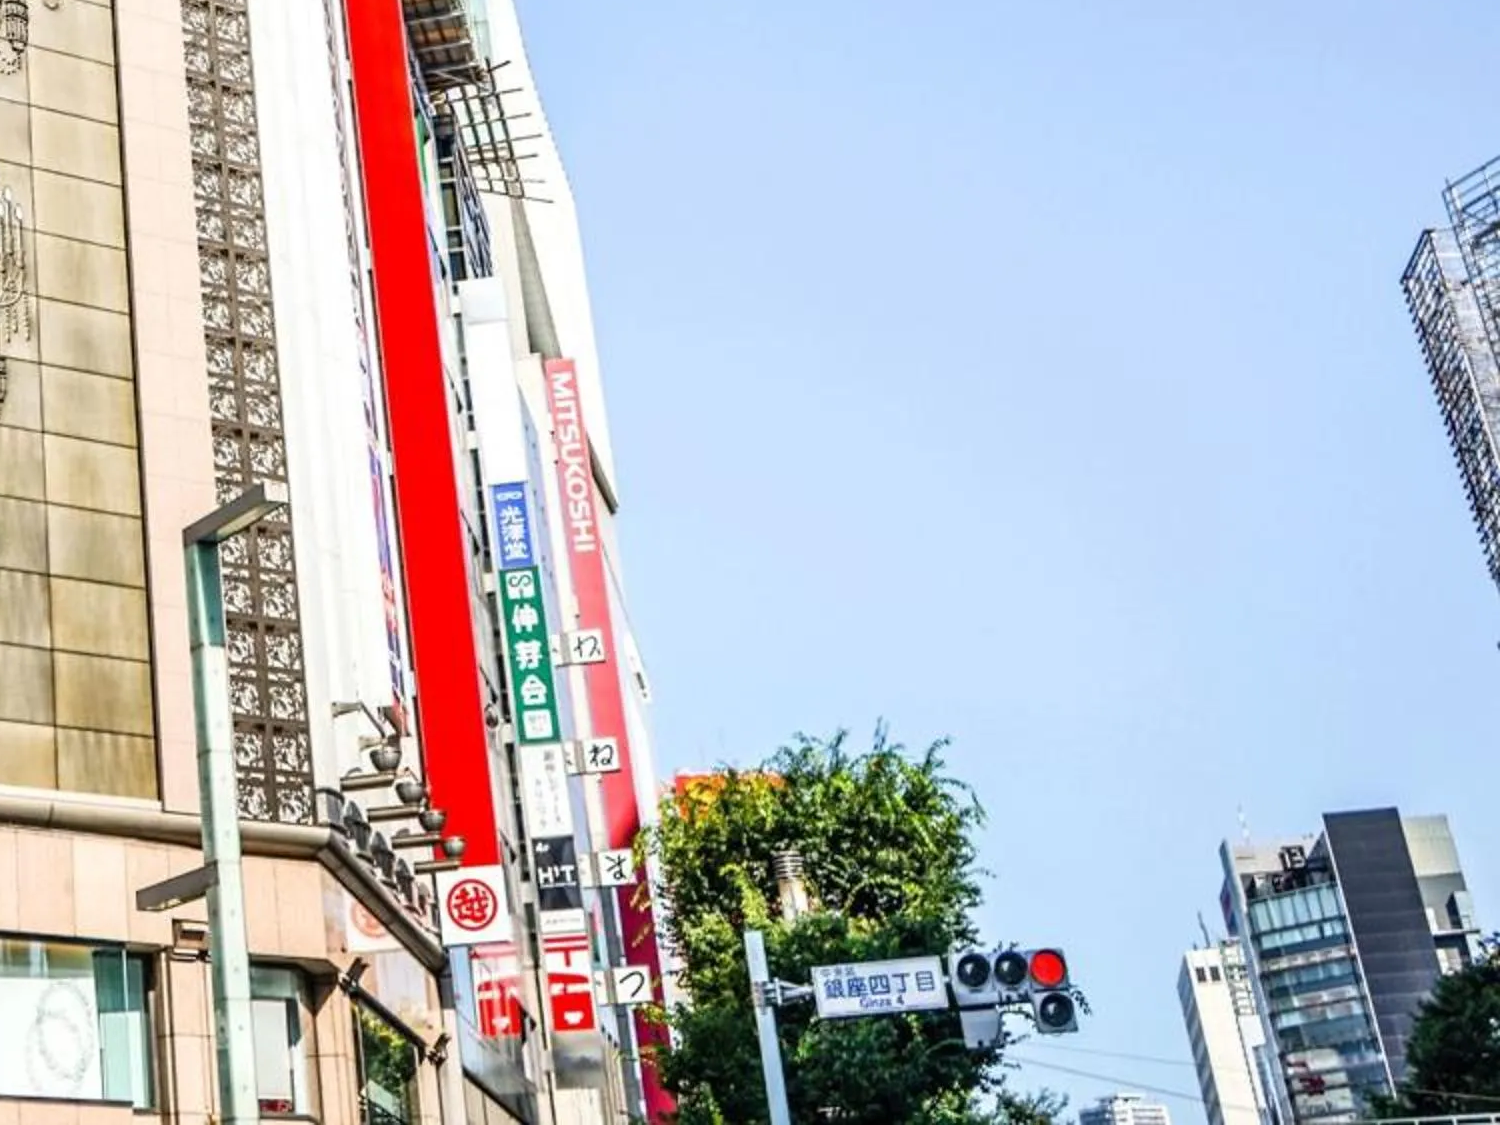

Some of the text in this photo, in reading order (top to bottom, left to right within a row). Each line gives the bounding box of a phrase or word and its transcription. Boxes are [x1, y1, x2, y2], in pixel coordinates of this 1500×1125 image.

[551, 370, 596, 553] MITSUKOSHI
[823, 970, 936, 999] 銀座四丁目
